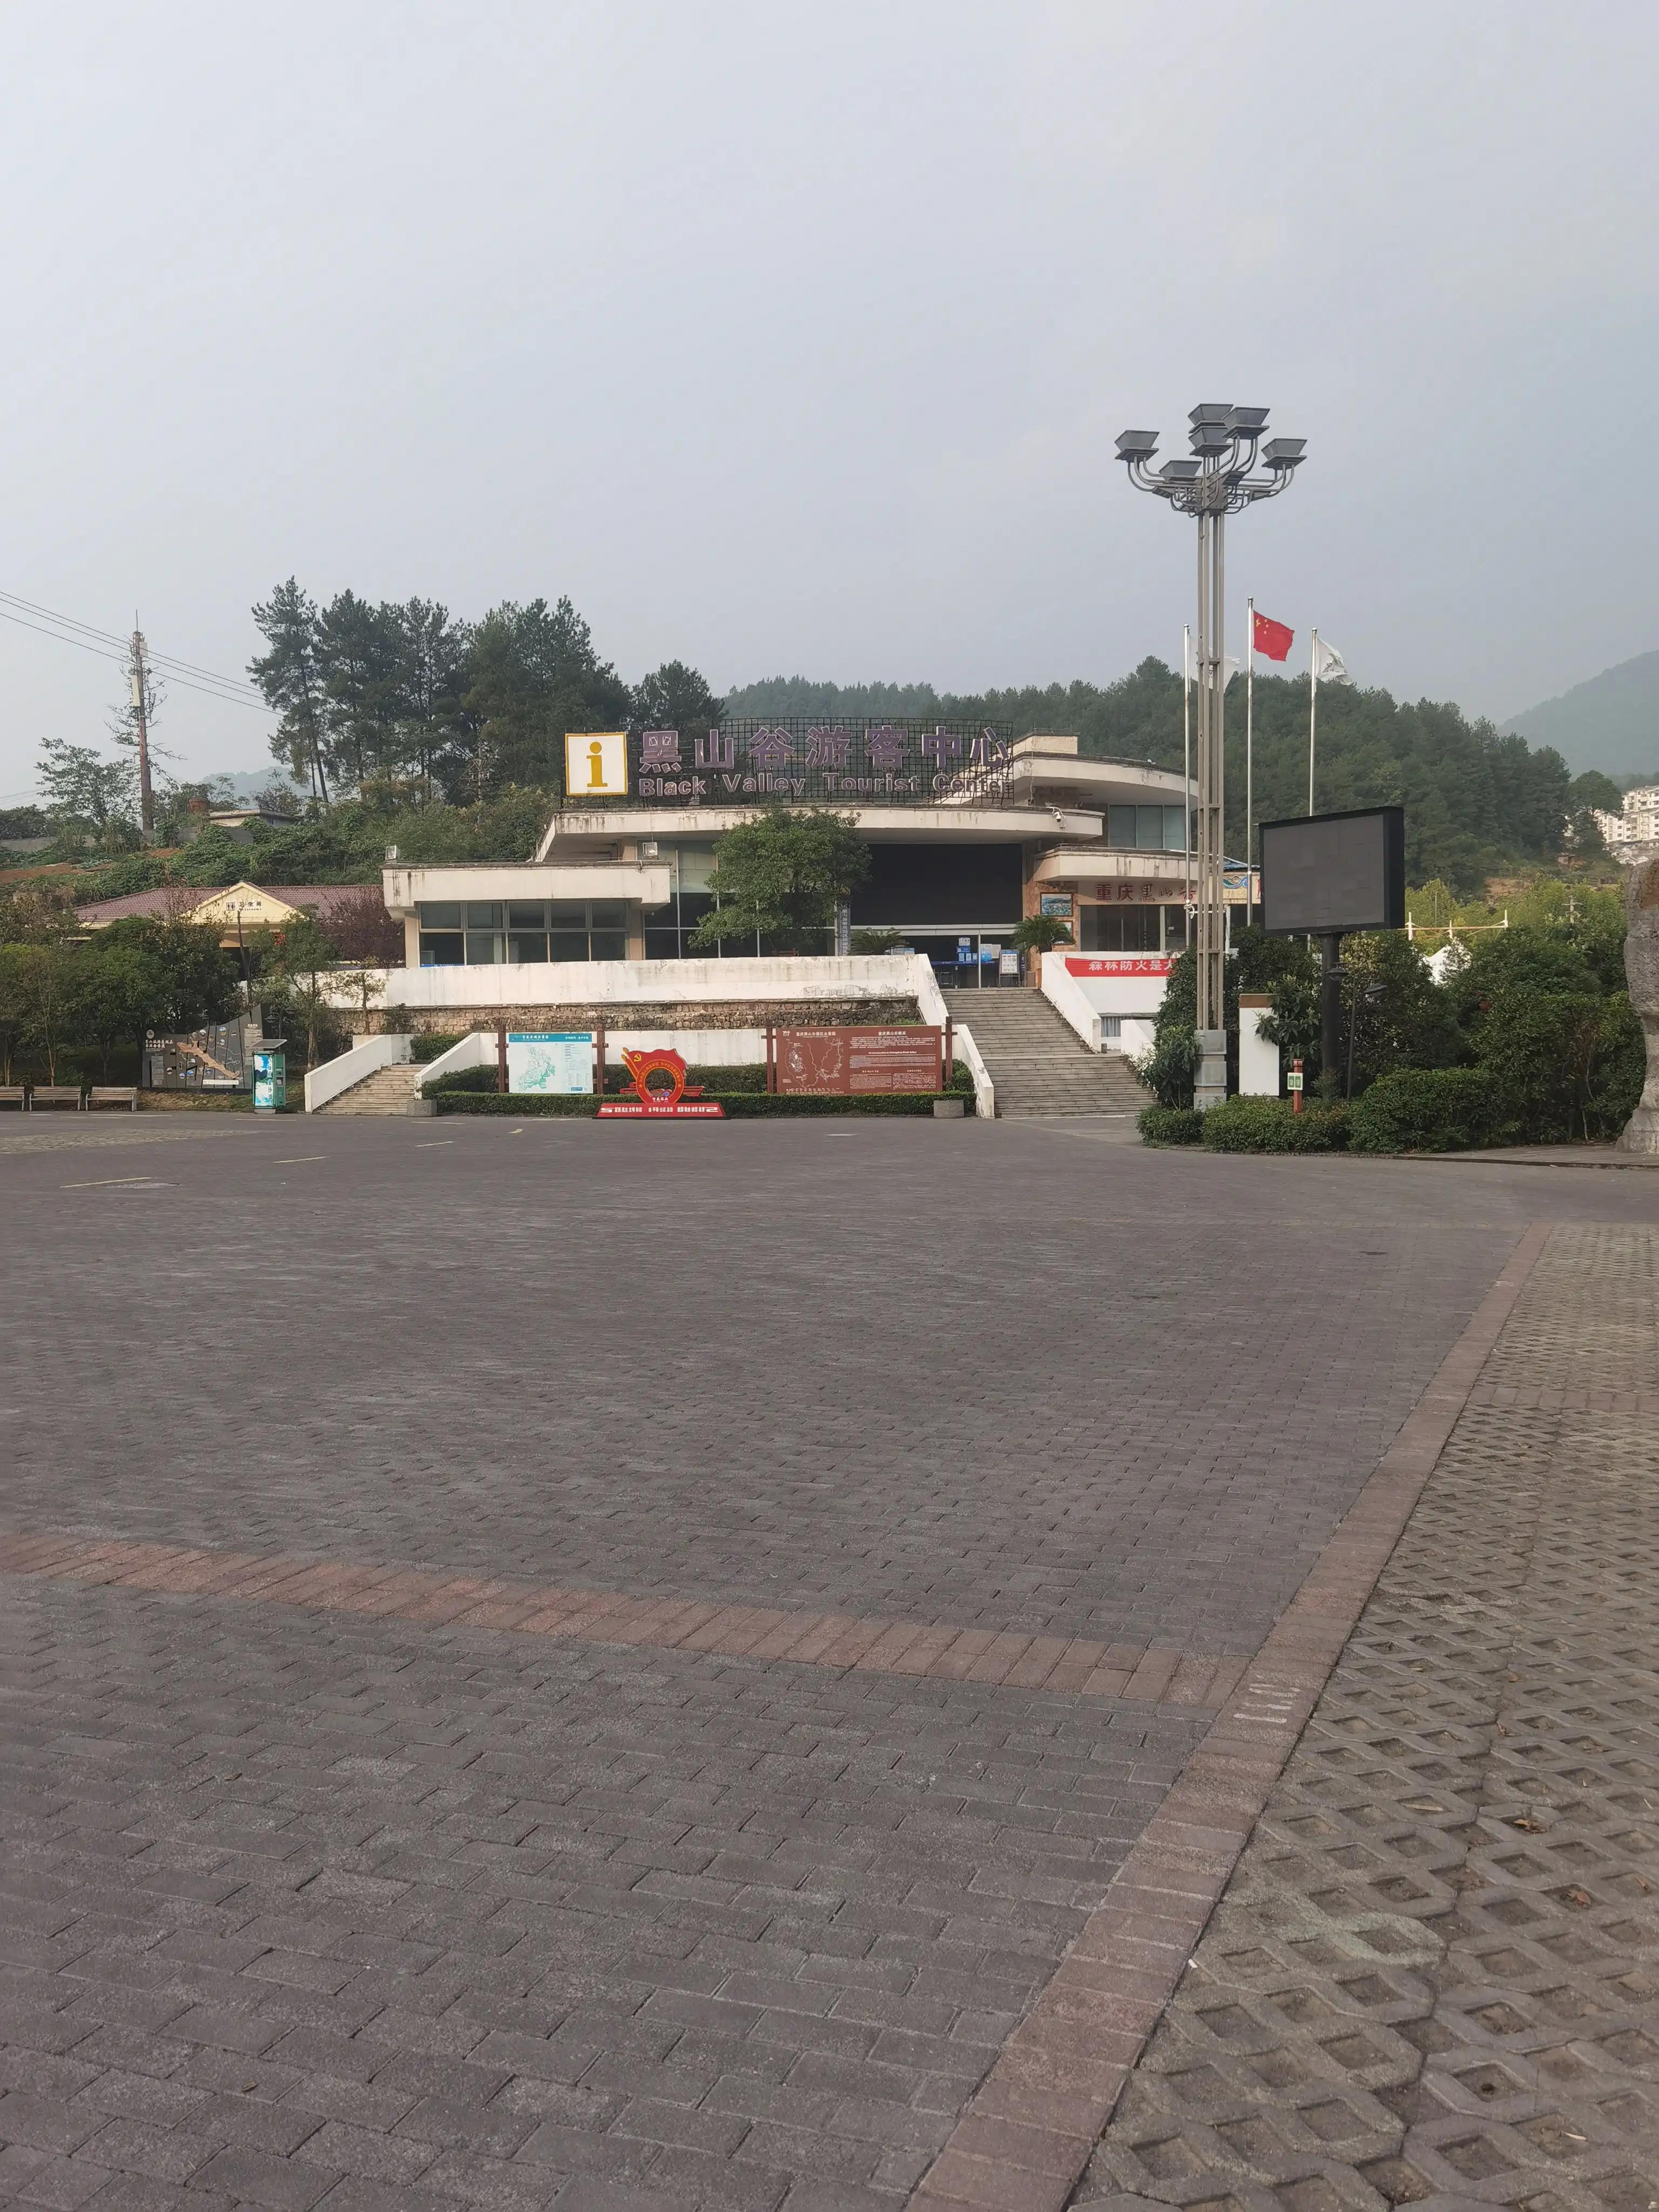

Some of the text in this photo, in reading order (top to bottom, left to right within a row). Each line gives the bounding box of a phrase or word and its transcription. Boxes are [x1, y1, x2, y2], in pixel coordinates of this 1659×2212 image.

[639, 725, 1009, 774] 黑山谷游客中心
[639, 772, 1011, 797] Black Valley Tourist Center
[1095, 882, 1197, 902] 重庆黑山谷
